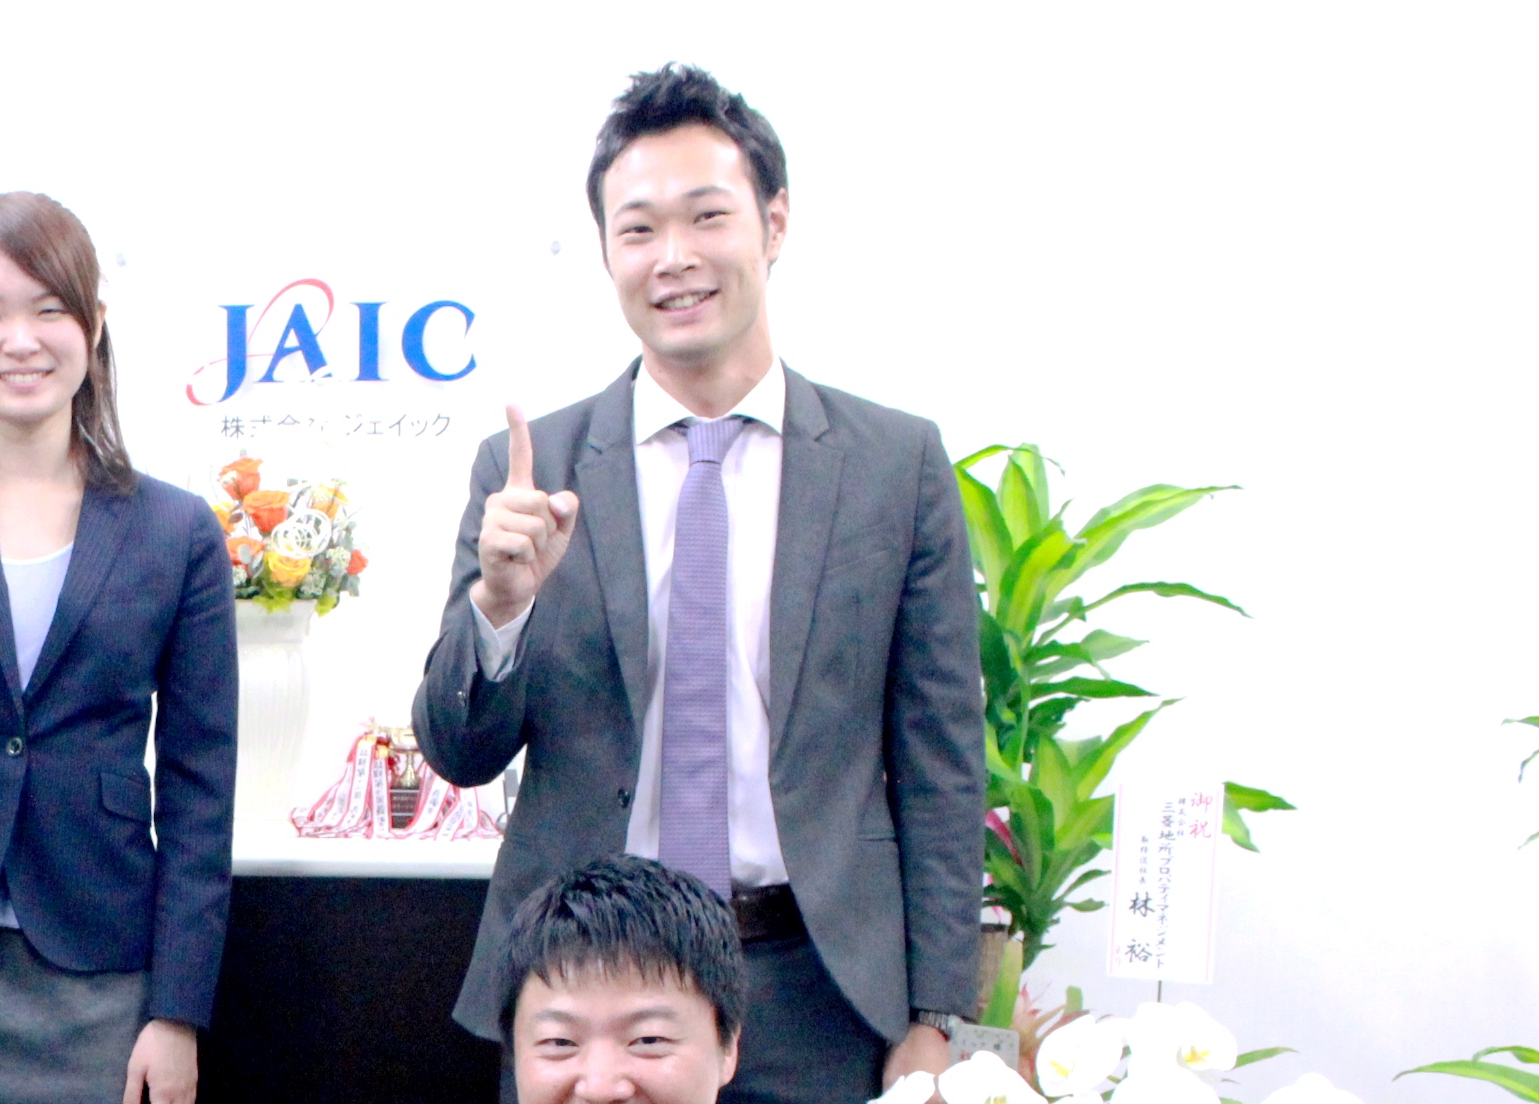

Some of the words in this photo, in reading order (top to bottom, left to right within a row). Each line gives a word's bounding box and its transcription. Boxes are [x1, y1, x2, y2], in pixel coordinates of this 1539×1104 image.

[216, 299, 478, 404] JAIC
[220, 412, 452, 440] 株会ジェイック
[1188, 791, 1214, 839] 御祝
